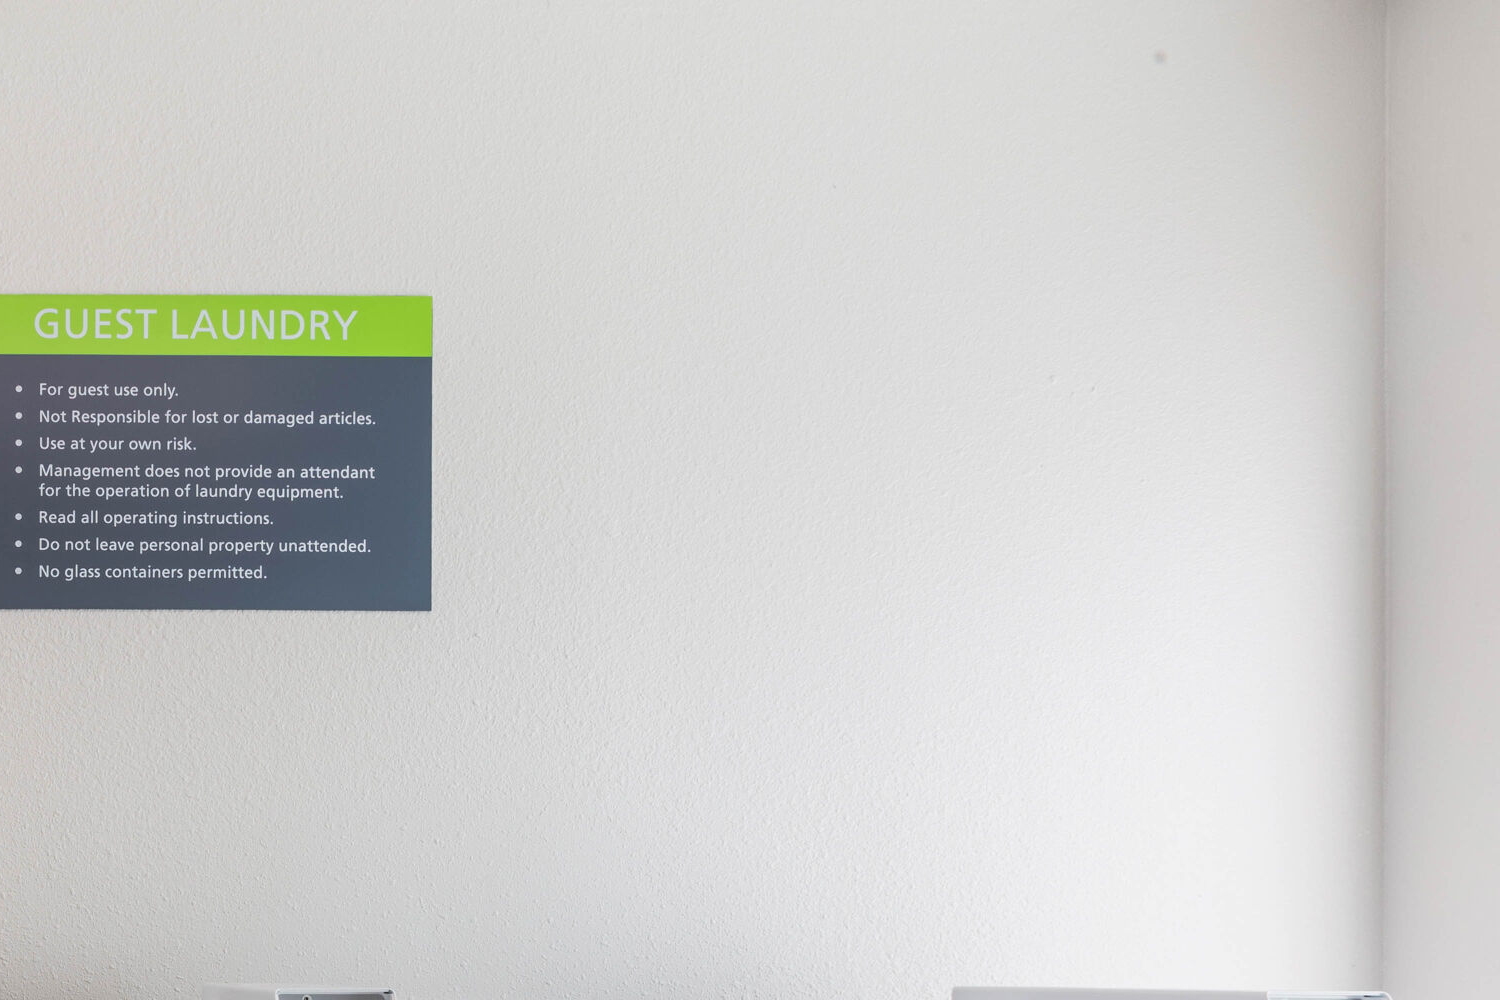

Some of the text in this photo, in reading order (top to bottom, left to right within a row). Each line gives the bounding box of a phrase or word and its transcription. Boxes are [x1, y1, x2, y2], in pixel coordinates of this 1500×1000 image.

[35, 308, 358, 340] GUEST LAUNDRY
[39, 382, 179, 400] For guest use only.
[40, 409, 376, 427] Not Responsible for lost or damaged articles.
[40, 436, 197, 453] Use at your own risk.
[40, 464, 375, 481] Management does not provide an attendant
[39, 483, 343, 501] for the operation of laundry equipment.
[39, 510, 273, 527] Read all operating instructions.
[39, 537, 371, 555] Do not leave personal property unattended.
[39, 564, 267, 582] No glass containers permitted.
